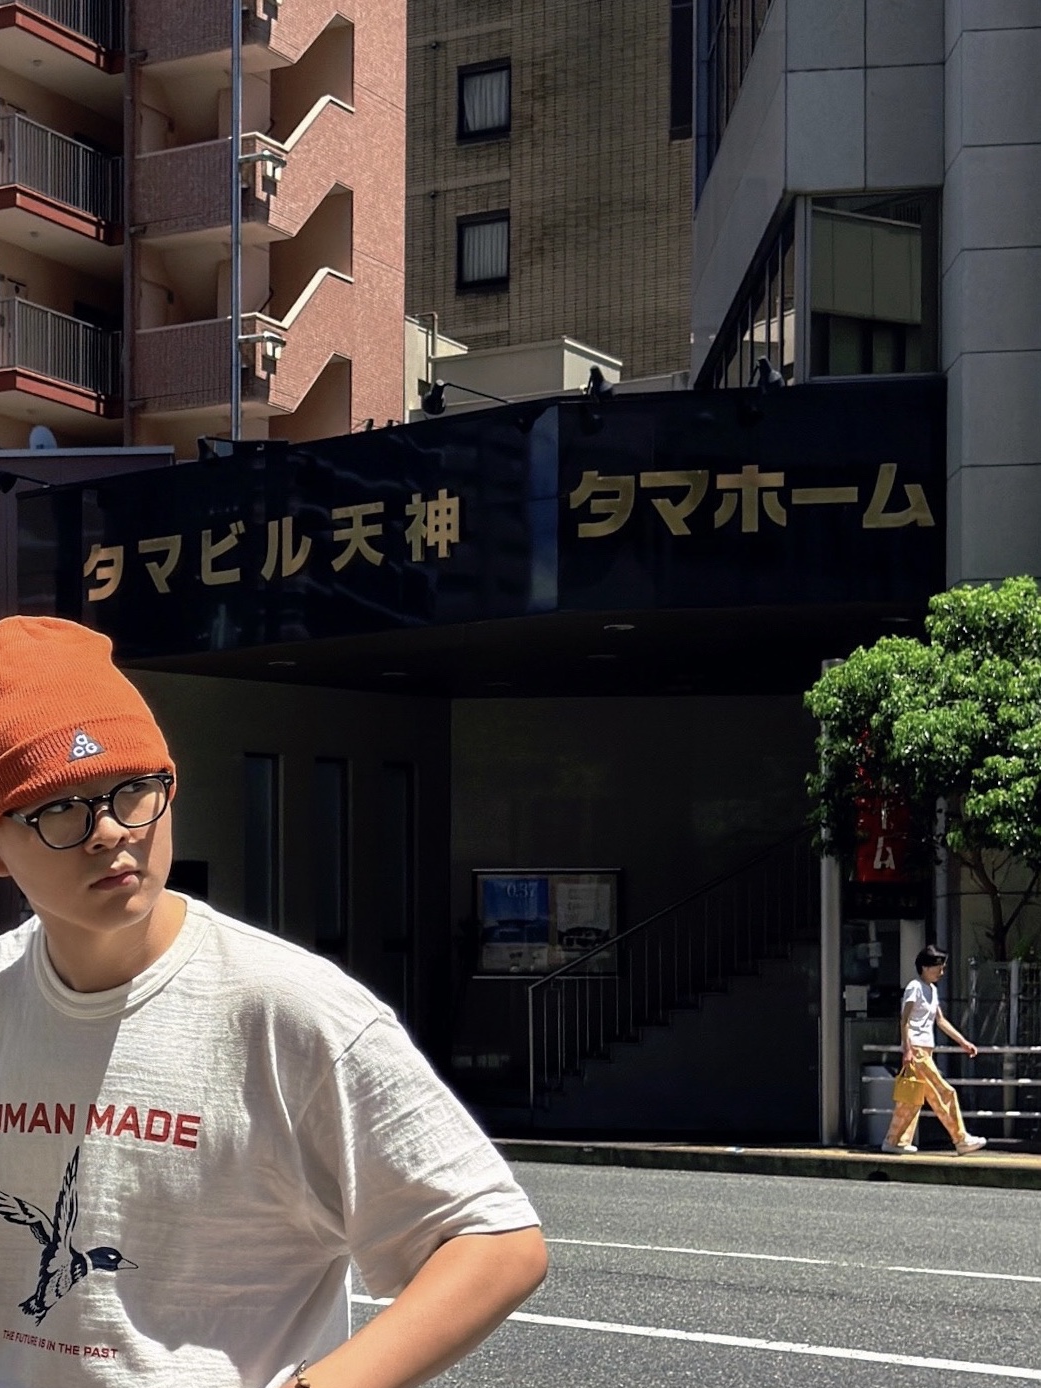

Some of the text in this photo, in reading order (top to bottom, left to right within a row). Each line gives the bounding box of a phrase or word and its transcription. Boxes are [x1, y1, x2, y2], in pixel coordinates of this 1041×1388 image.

[568, 461, 936, 539] タマホーム
[82, 488, 462, 603] タマビル天神
[85, 1104, 201, 1149] MADE
[3, 1329, 118, 1358] THE FUTURE IS IN THE PAST
